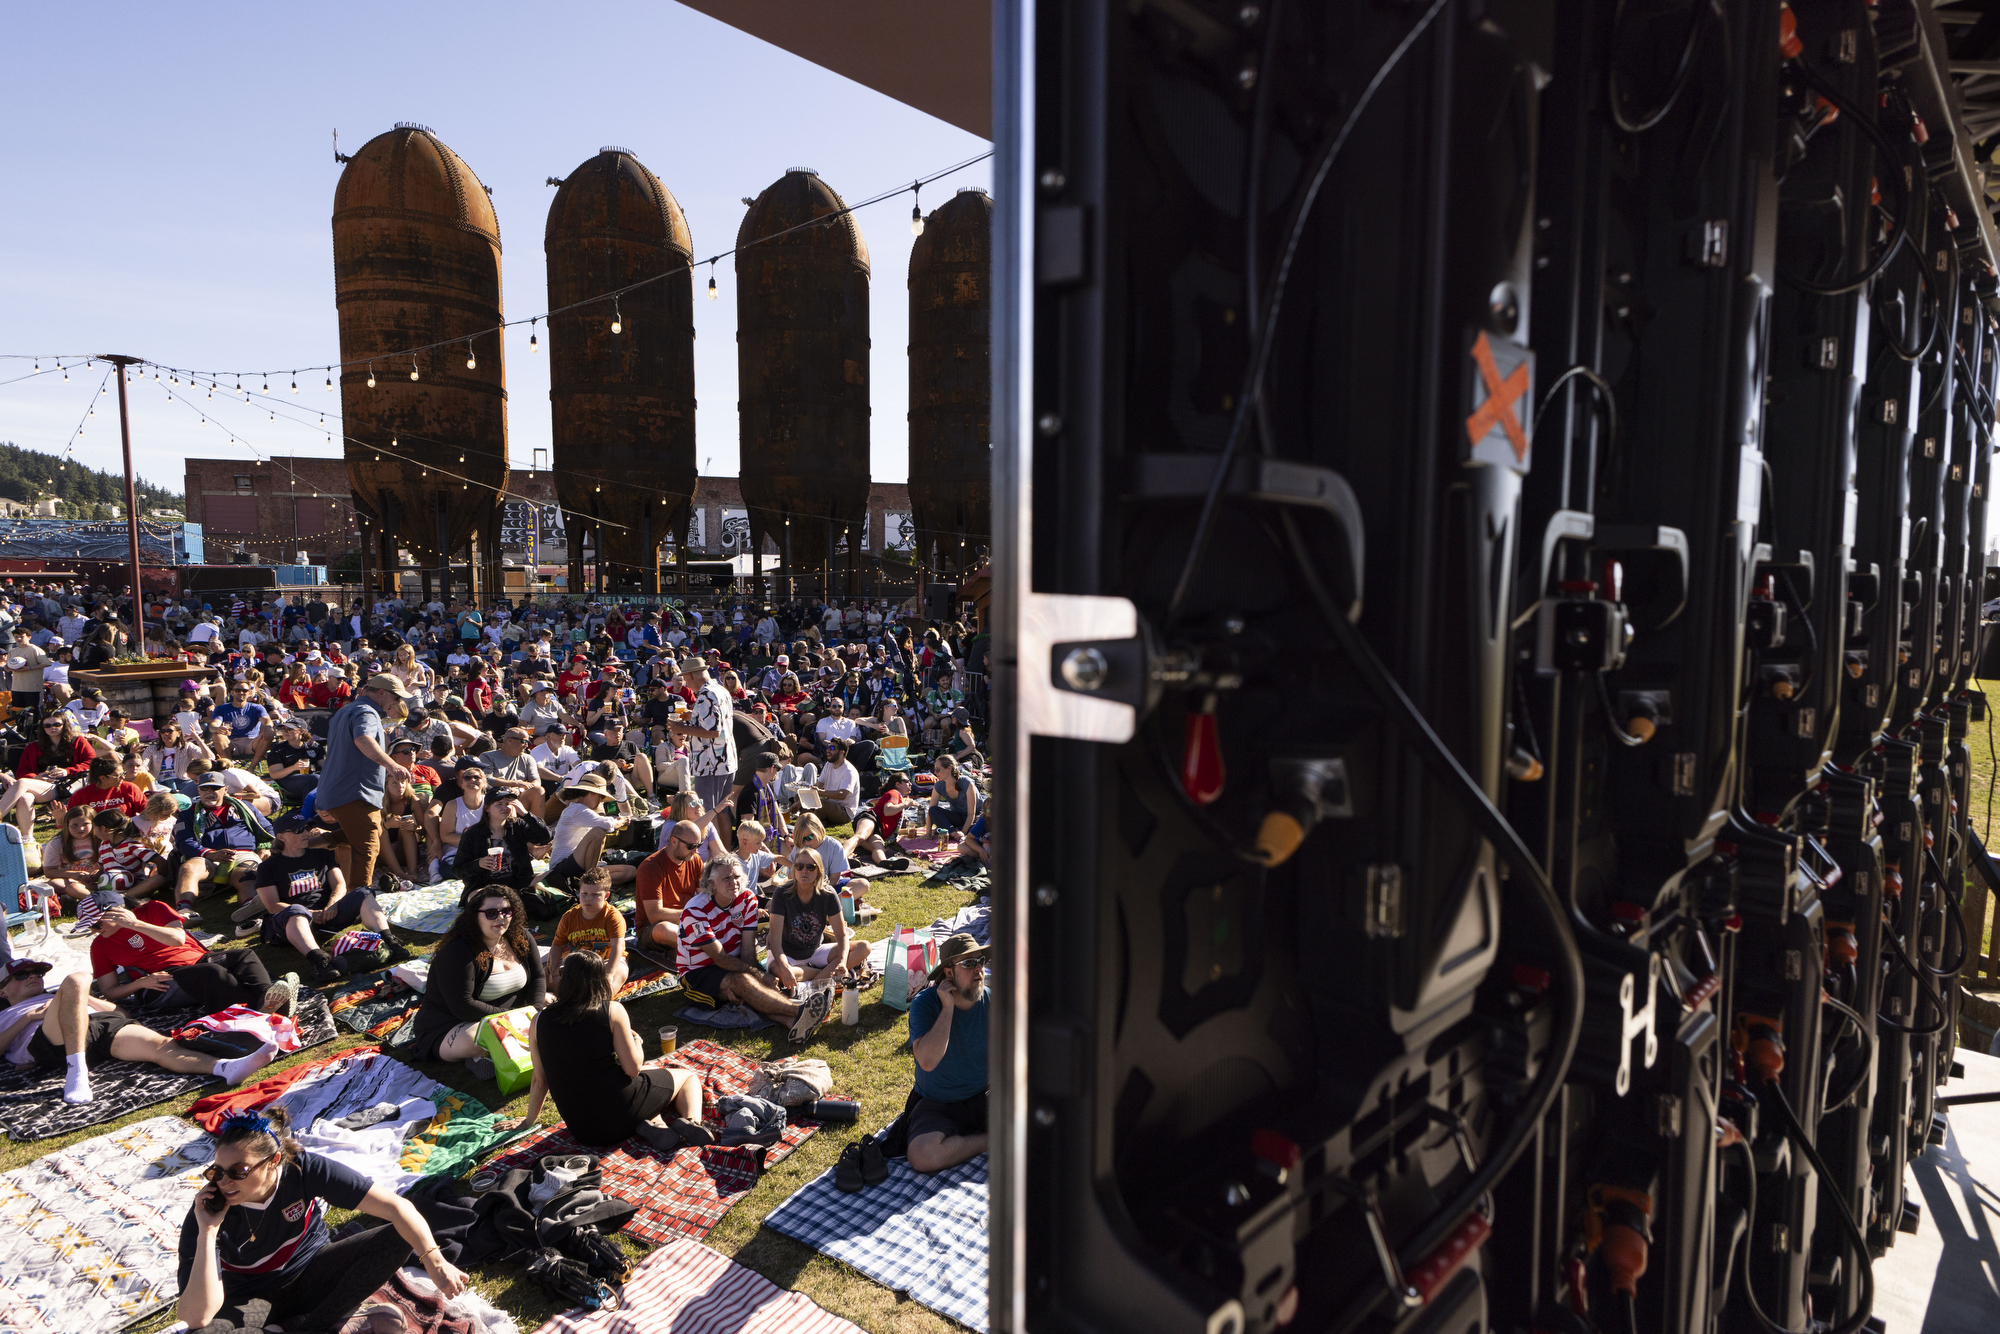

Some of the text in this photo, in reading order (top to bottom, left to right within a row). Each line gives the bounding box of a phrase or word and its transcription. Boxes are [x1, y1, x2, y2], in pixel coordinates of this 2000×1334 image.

[89, 797, 125, 809] SALMON
[292, 872, 313, 881] USA
[396, 1095, 466, 1174] MEXIC
